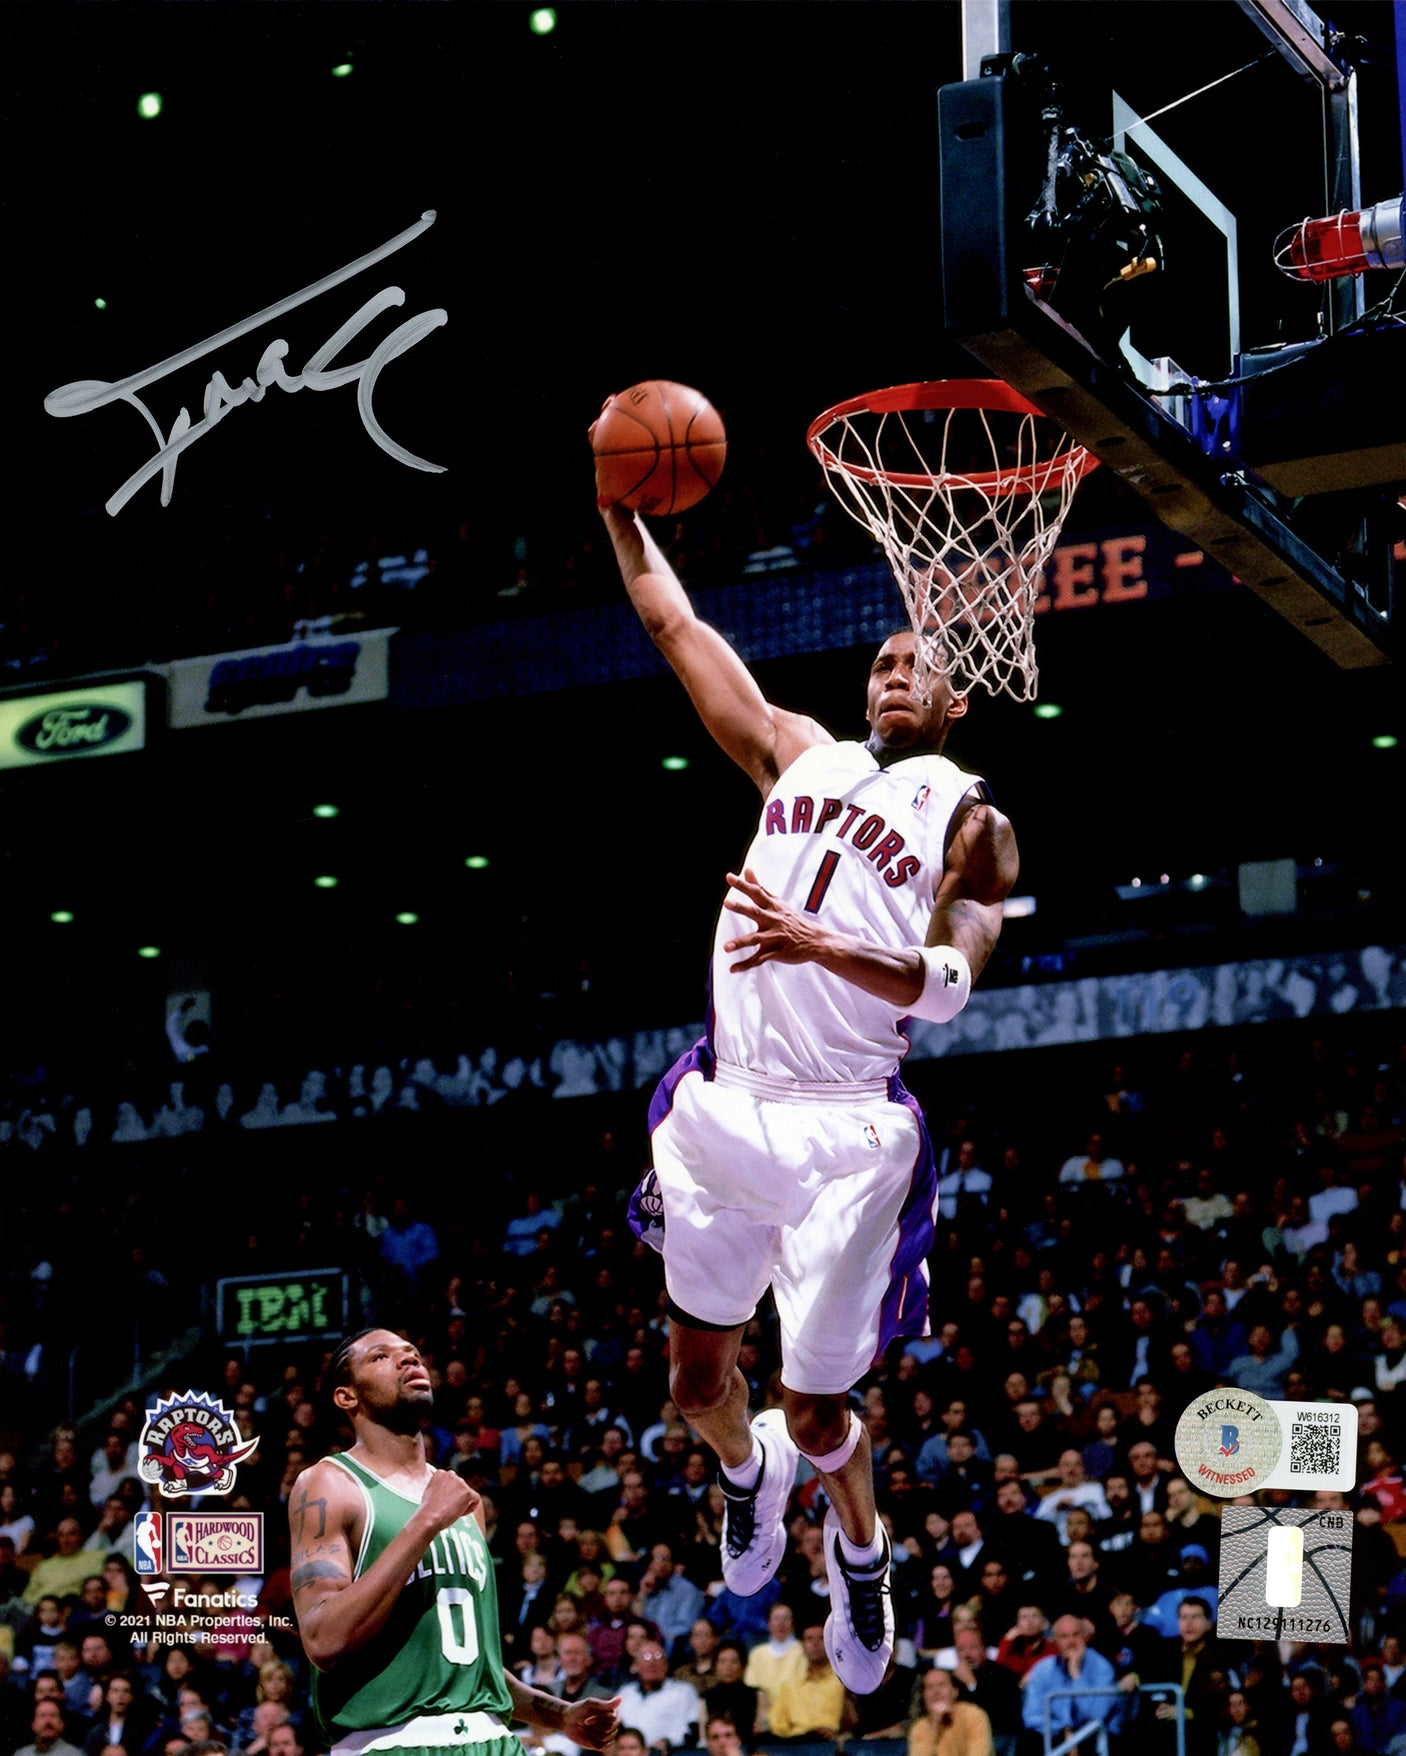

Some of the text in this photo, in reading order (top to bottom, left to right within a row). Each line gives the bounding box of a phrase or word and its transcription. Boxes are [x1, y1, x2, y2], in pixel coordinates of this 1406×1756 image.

[35, 708, 110, 750] Ford
[765, 796, 921, 888] RAPTORS
[804, 850, 841, 914] 1
[1196, 1398, 1264, 1422] BECKETT
[1297, 1411, 1340, 1423] W616312
[1198, 1463, 1256, 1485] WITNESSED
[1319, 1516, 1344, 1529] CNB
[405, 1525, 487, 1593] LTICS
[436, 1587, 479, 1665] 0
[1238, 1616, 1331, 1633] NC129111276
